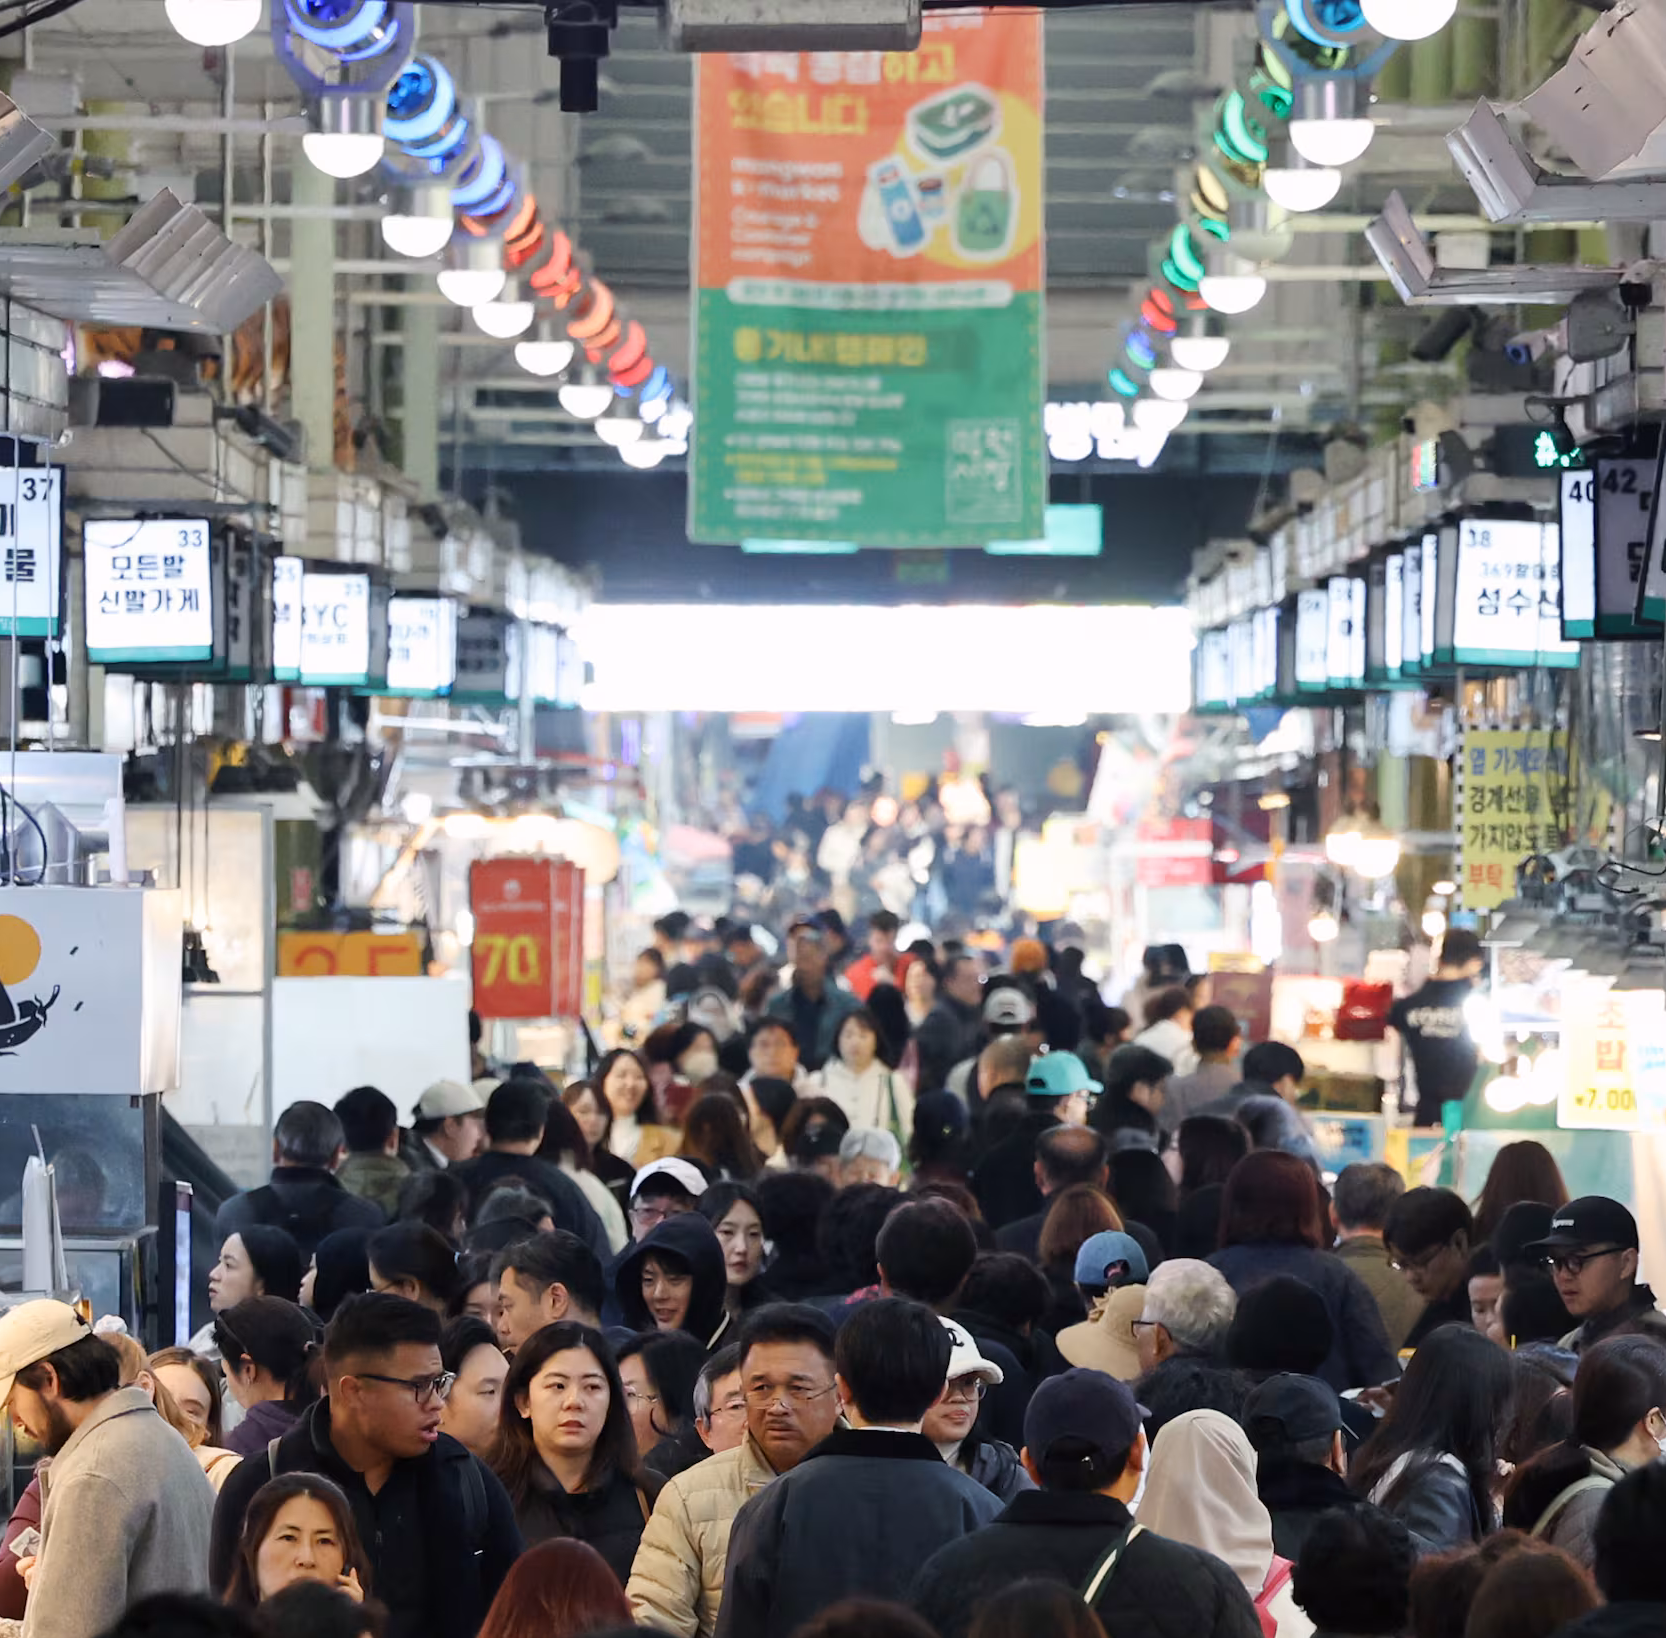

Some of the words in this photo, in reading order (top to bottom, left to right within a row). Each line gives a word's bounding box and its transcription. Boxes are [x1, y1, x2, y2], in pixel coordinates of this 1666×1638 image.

[22, 477, 54, 502] 37
[1602, 467, 1639, 494] 42
[178, 529, 203, 548] 33
[110, 554, 186, 581] 모든발
[99, 587, 200, 615] 신발가게
[1468, 863, 1504, 892] 부탁
[476, 933, 540, 987] 70
